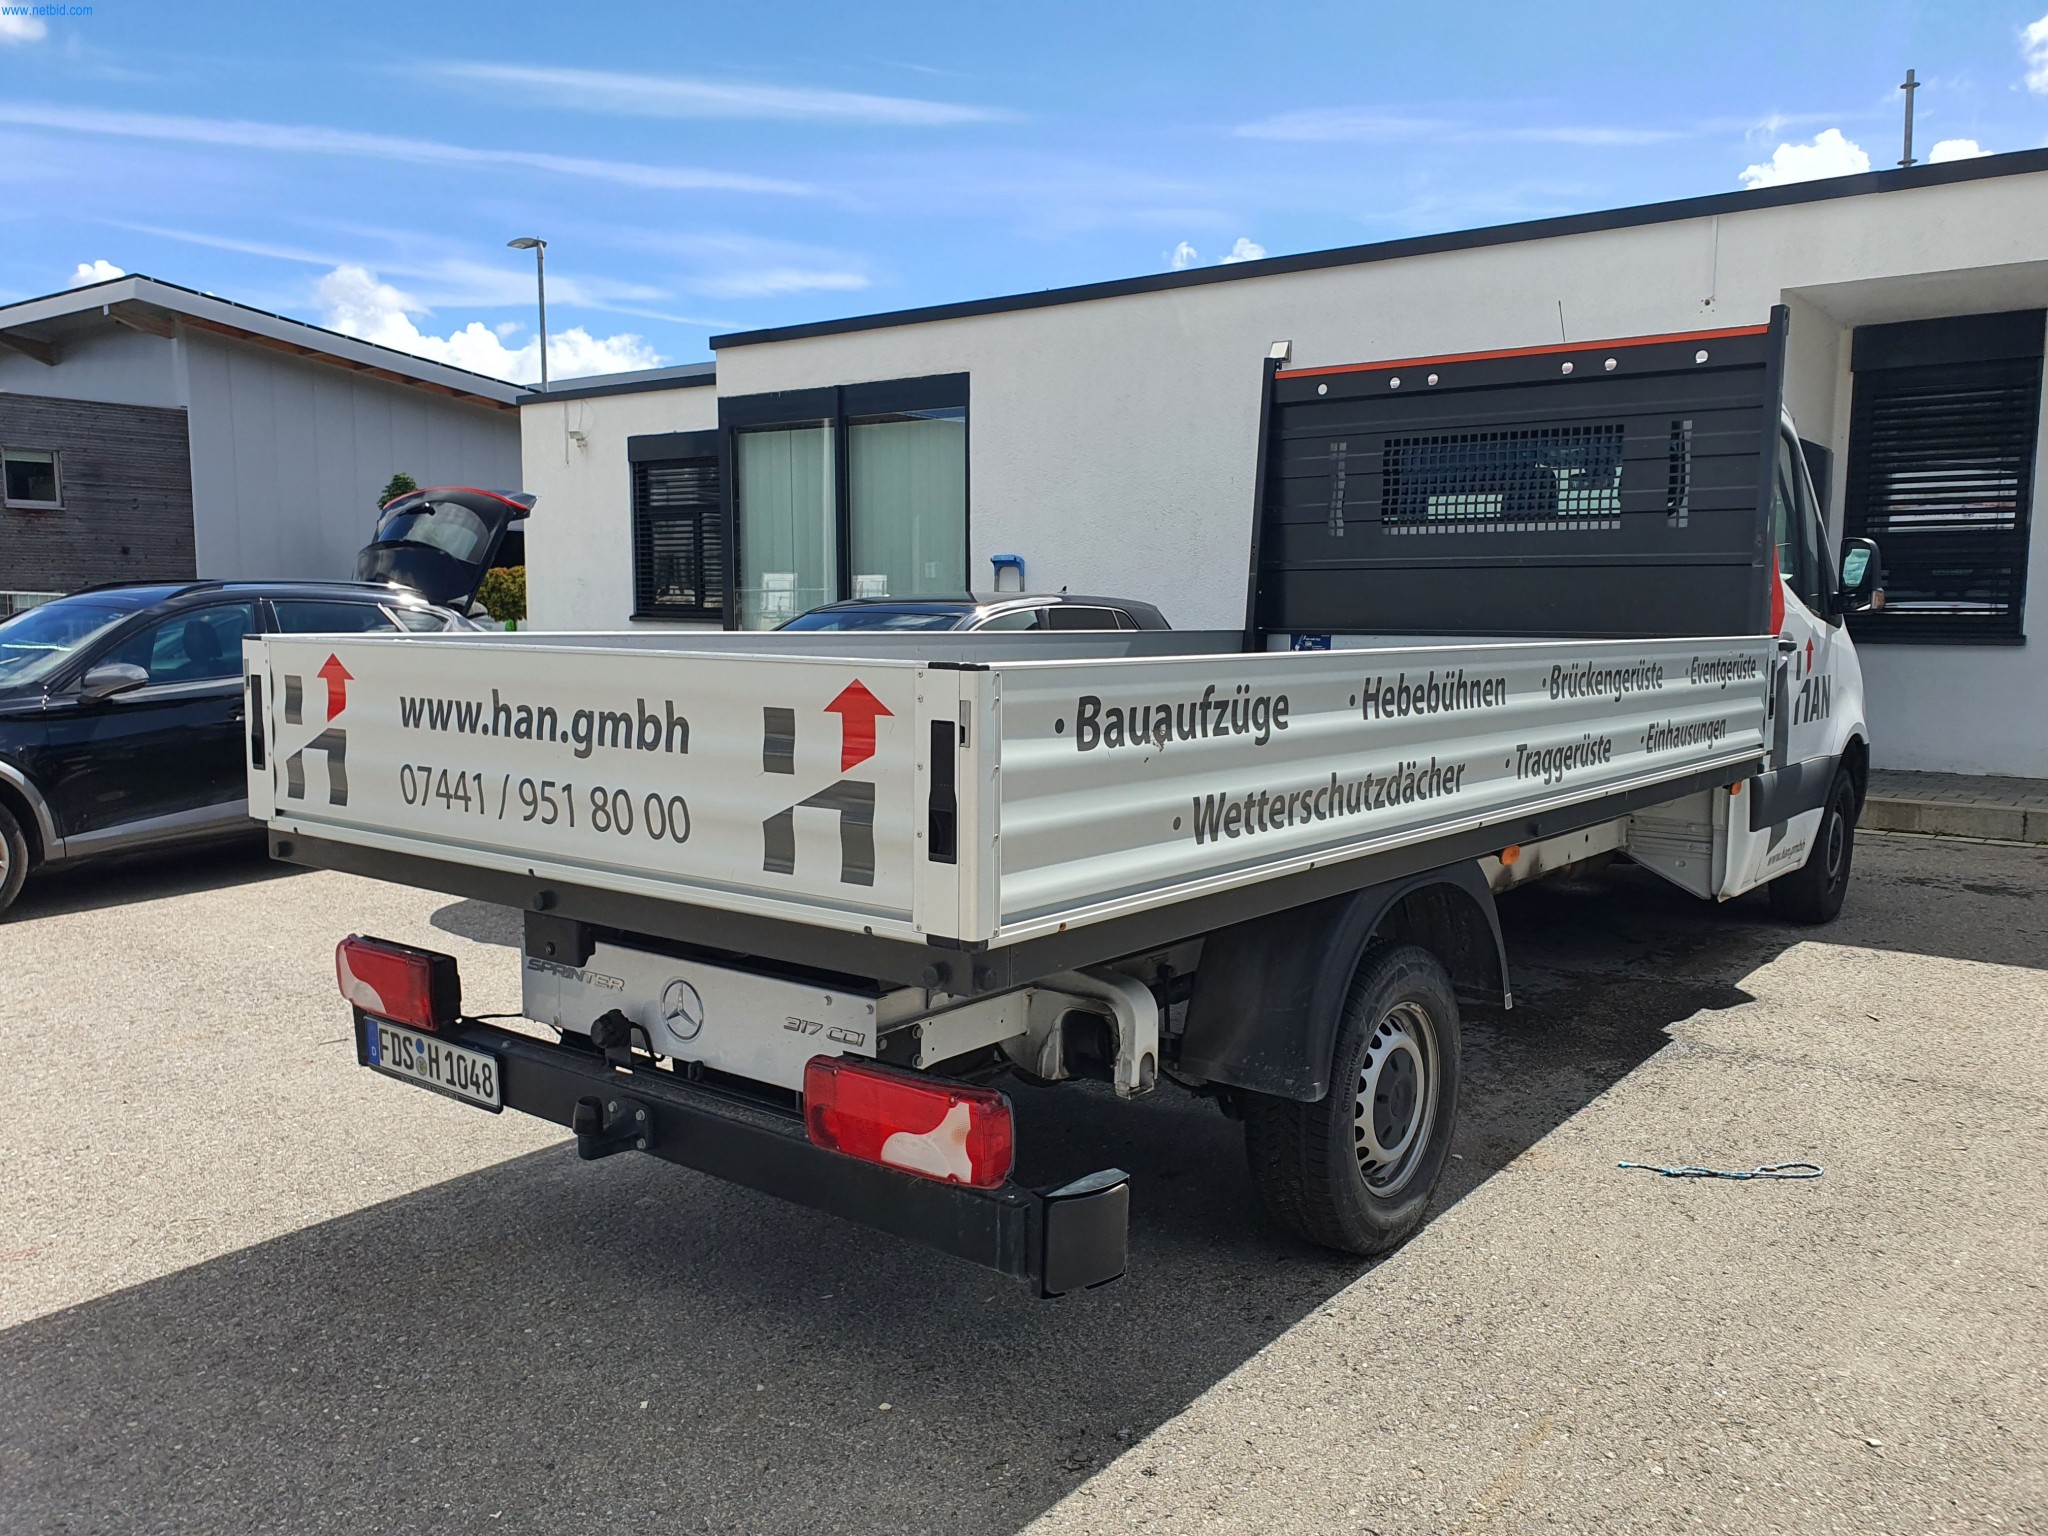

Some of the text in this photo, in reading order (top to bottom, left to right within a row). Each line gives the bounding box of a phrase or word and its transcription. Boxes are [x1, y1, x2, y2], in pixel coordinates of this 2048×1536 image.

[1362, 669, 1507, 721] Hebebühnen
[1549, 660, 1664, 703] Brückengerüste
[1690, 653, 1757, 690] Eventgerüste
[400, 689, 690, 759] www.han.gmbh
[1076, 684, 1290, 752] Bauaufzüge
[1646, 717, 1727, 754] Einhausungen
[1516, 734, 1612, 785] Traggerüste
[400, 764, 691, 844] 07441 / 951 80 00
[1192, 756, 1467, 846] Wetterschutzdächer
[527, 958, 625, 992] SPRINTER
[783, 1016, 866, 1048] 317 CDI
[378, 1027, 415, 1070] FDS
[427, 1043, 441, 1081] H
[444, 1050, 494, 1099] 1048
